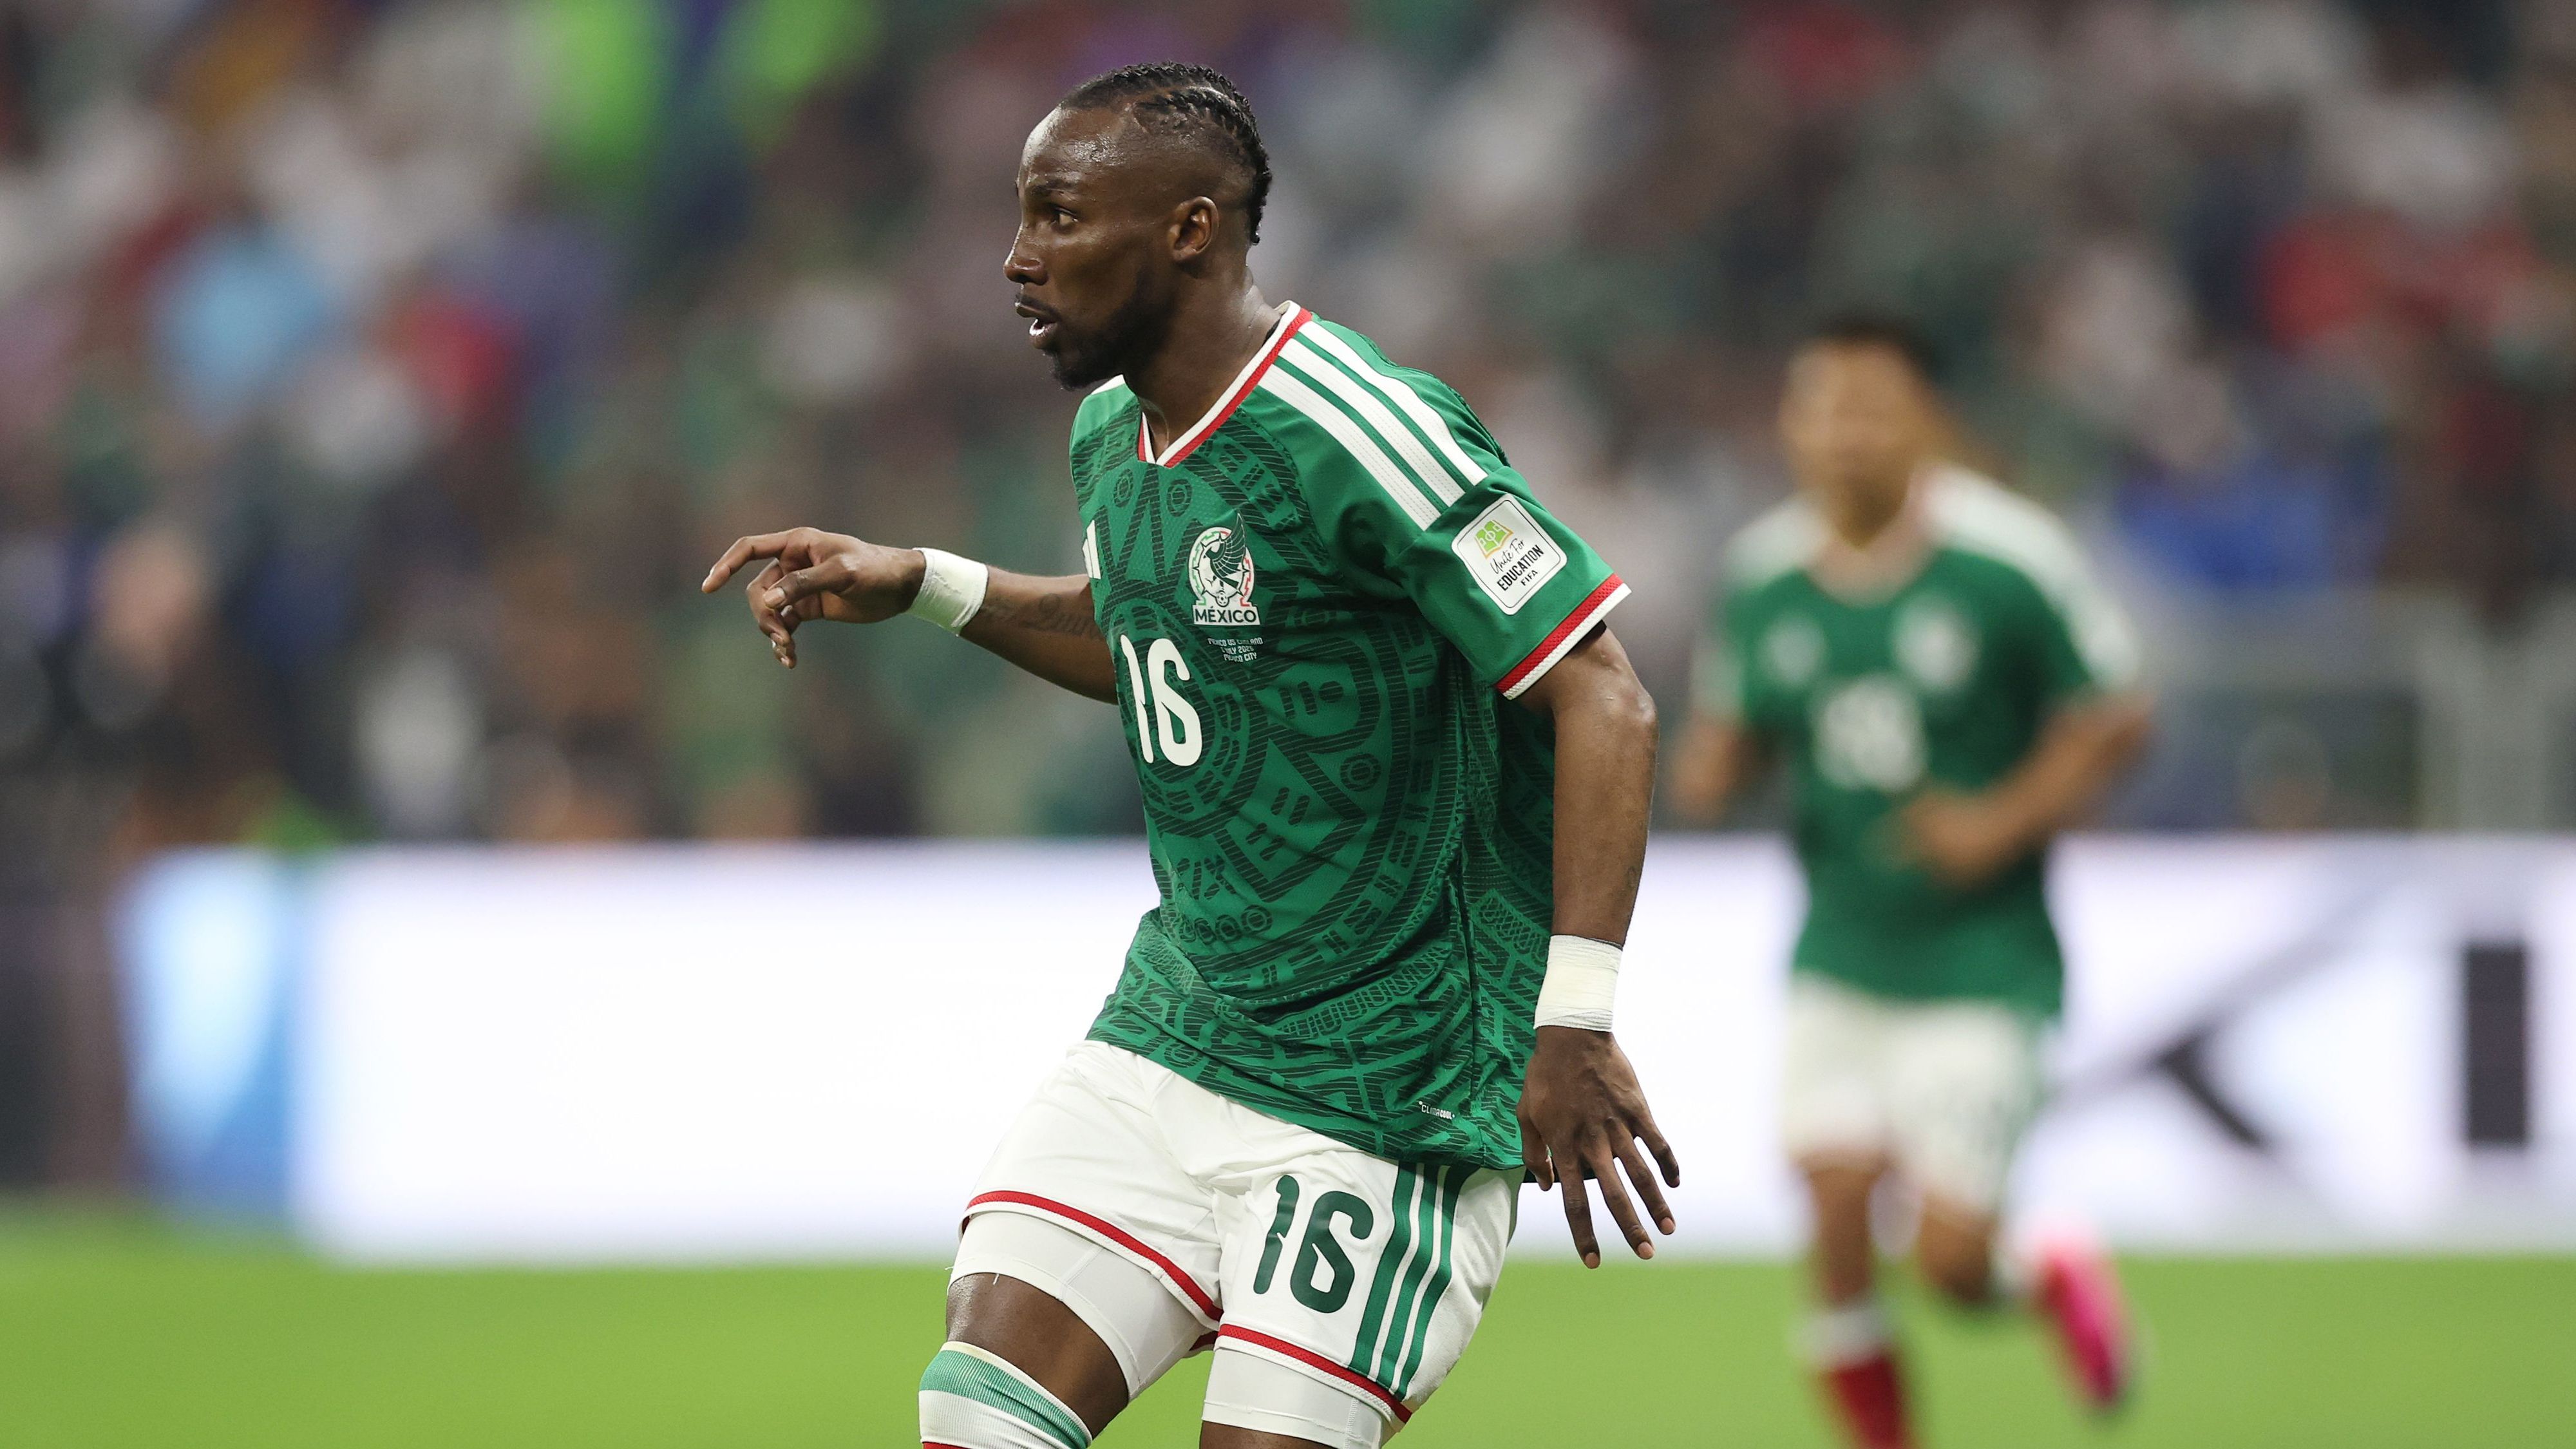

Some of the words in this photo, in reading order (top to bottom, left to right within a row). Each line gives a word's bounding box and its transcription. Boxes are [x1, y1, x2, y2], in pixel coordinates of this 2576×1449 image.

[1490, 551, 1513, 574] Unite
[1509, 538, 1525, 554] For
[1497, 544, 1544, 591] EDUCATION
[1520, 569, 1539, 586] FIFA
[1195, 606, 1256, 623] MÉXICO
[1244, 652, 1257, 661] CITY
[1121, 634, 1202, 766] 16
[1253, 1174, 1375, 1314] 16
